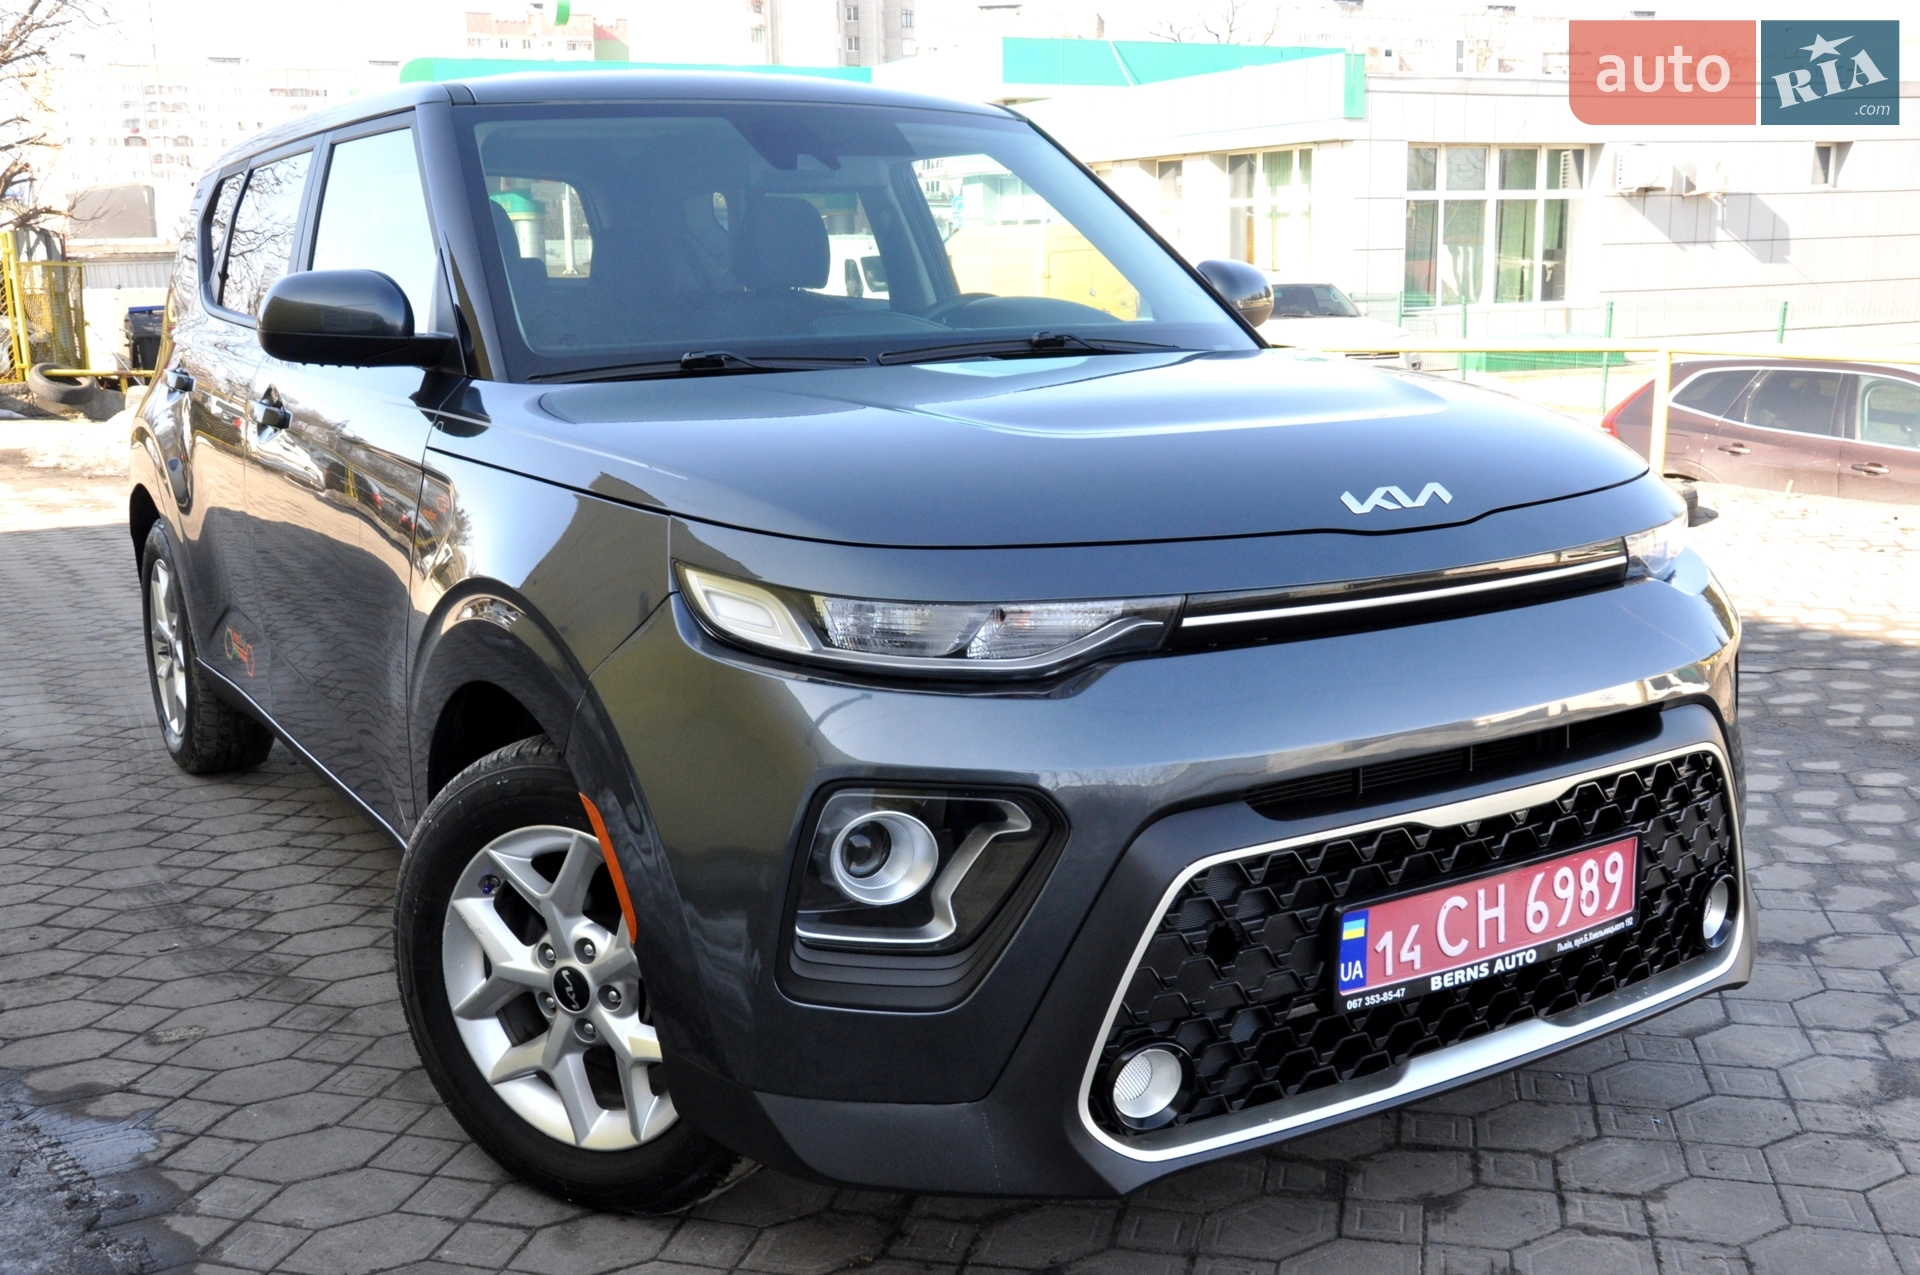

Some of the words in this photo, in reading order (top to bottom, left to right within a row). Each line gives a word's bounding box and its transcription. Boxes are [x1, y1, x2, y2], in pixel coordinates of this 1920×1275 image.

[1374, 924, 1421, 977] 14
[1436, 884, 1506, 957] CH
[1526, 851, 1624, 934] 6989
[1341, 960, 1364, 982] UA
[1431, 962, 1490, 991] BERNS
[1493, 949, 1537, 974] AUTO
[1346, 998, 1363, 1010] 067
[1364, 988, 1406, 1006] 353-85-47
